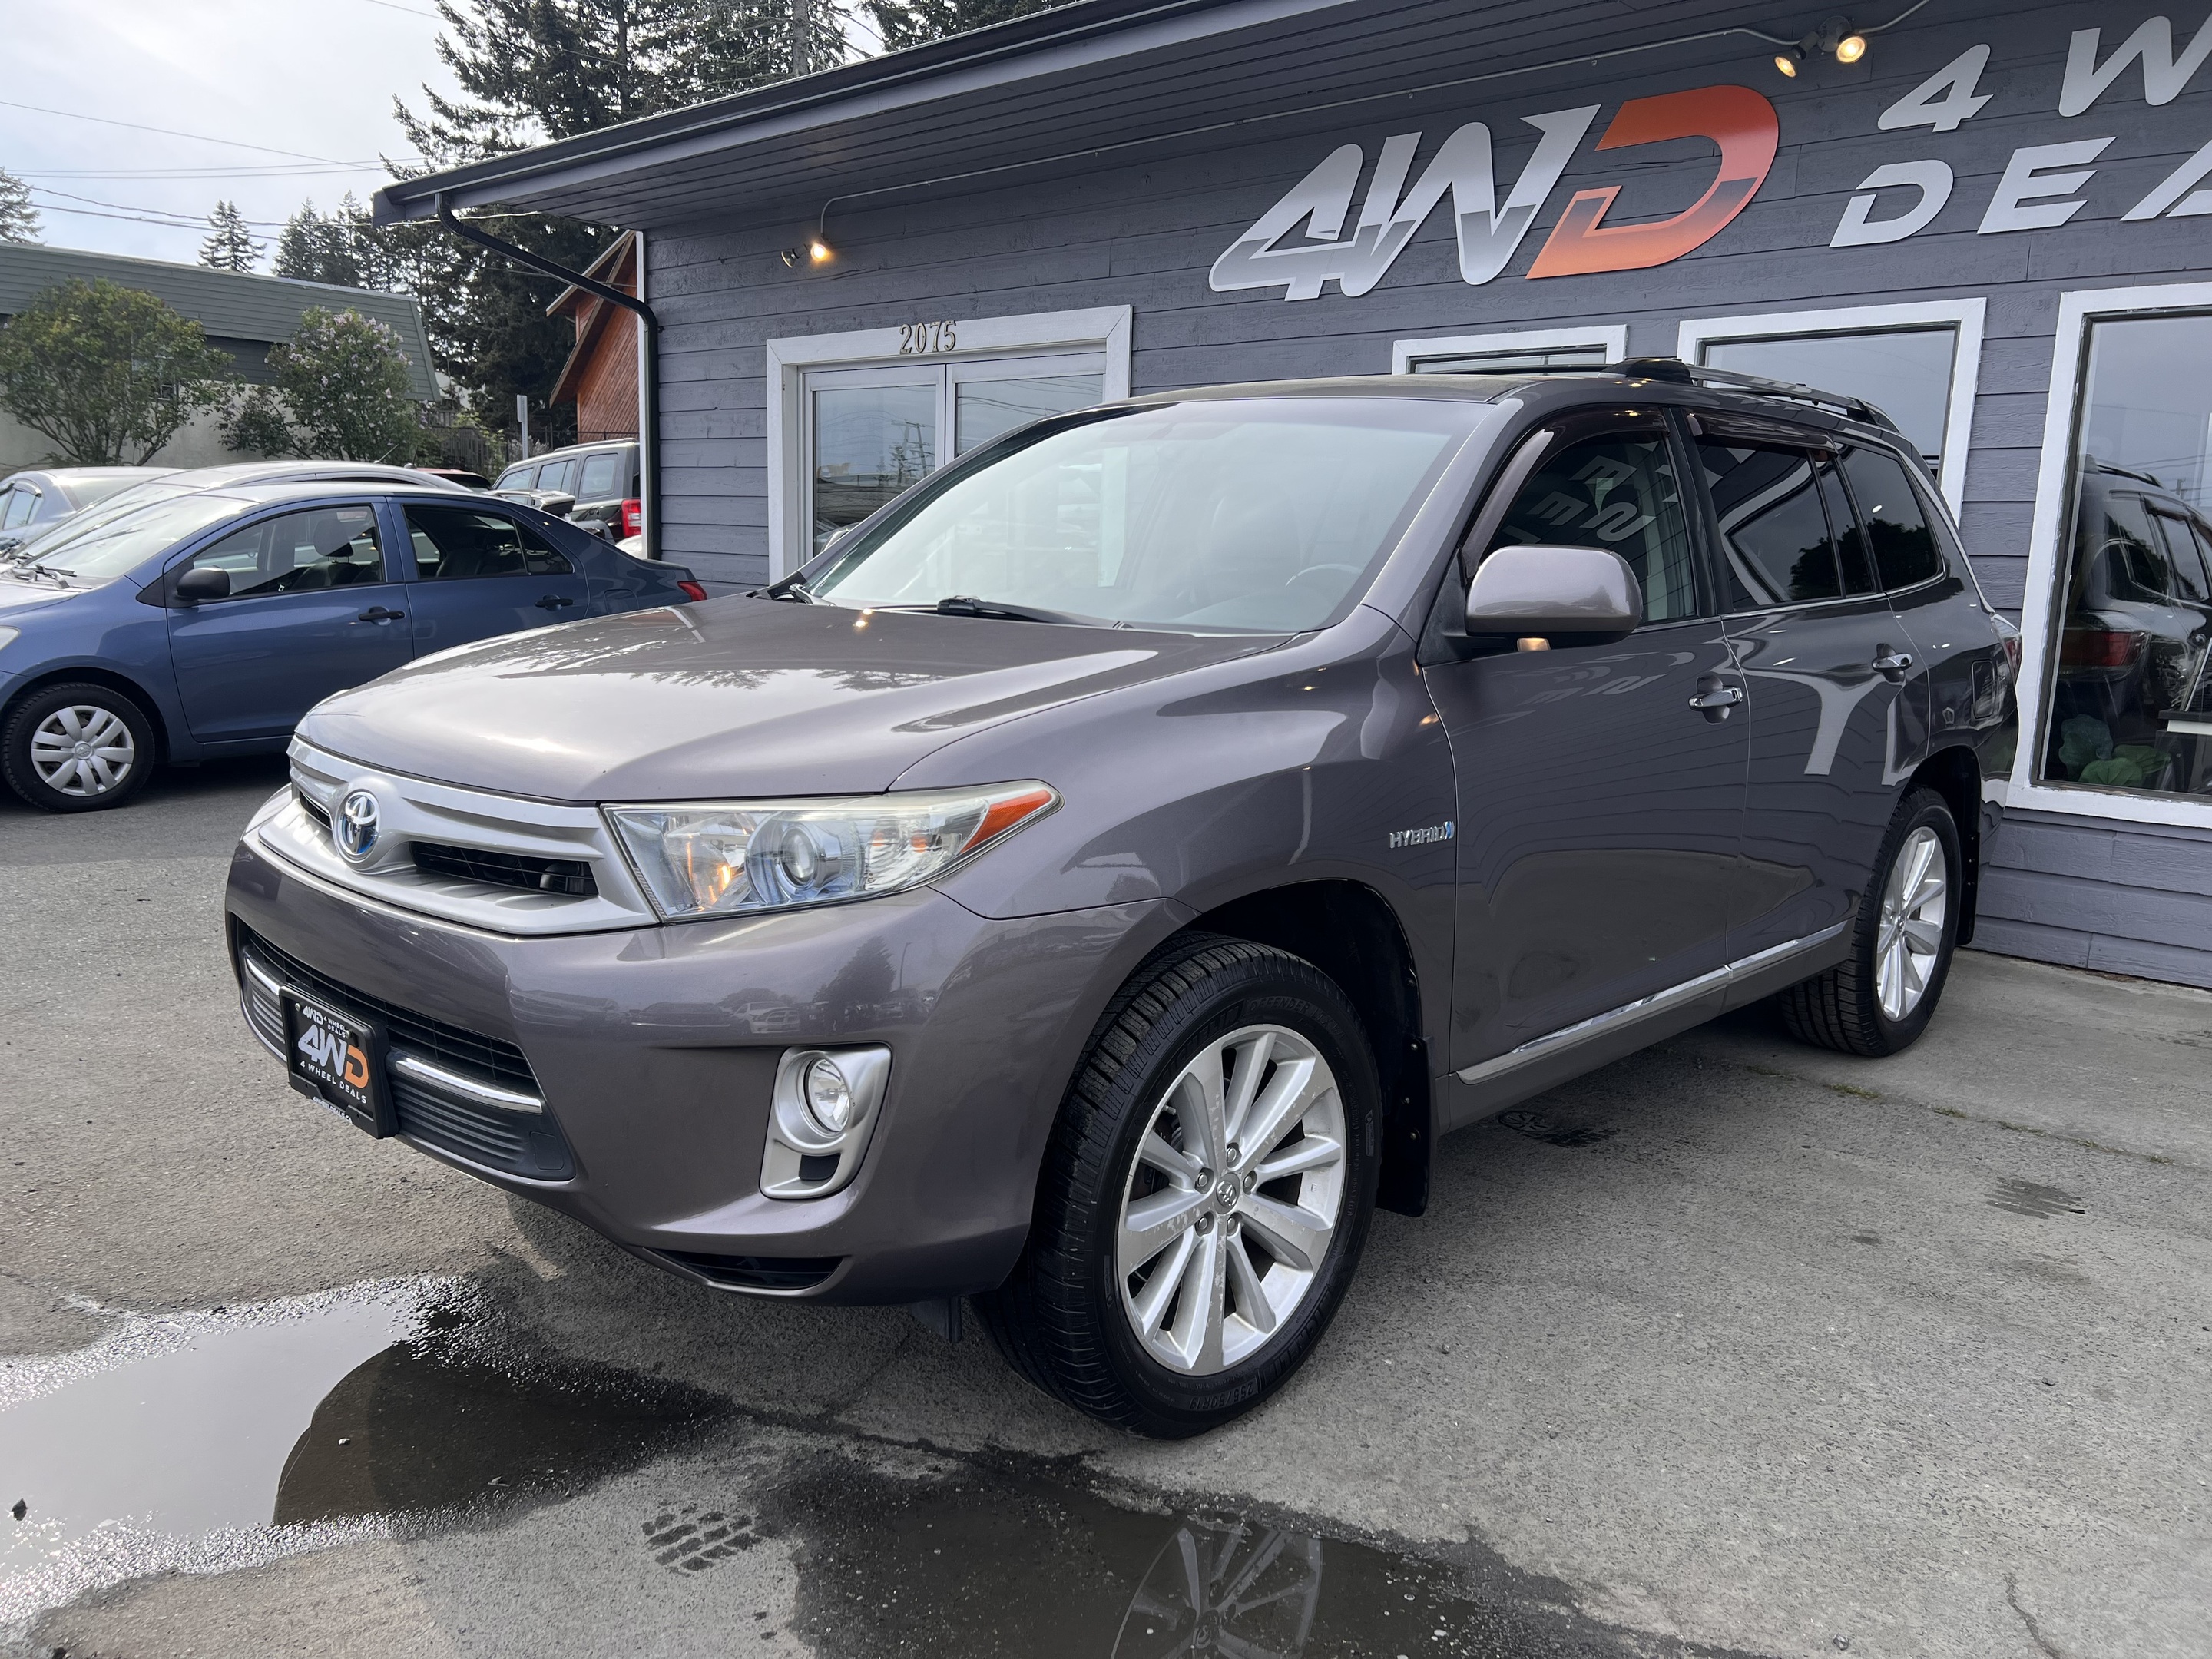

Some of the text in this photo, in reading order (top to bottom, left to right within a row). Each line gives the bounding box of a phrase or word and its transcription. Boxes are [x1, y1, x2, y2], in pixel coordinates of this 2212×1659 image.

[1877, 43, 1994, 132] 4
[1209, 84, 1780, 300] 4WD
[899, 320, 957, 355] 2075
[1389, 826, 1445, 849] HYBRID
[303, 1005, 323, 1025] 4WD
[1250, 997, 1310, 1013] DEFENDER
[328, 1018, 346, 1031] WHEEL
[298, 1024, 369, 1088] 4WD
[300, 1060, 366, 1104] 4 WHEEL DEALS
[1189, 1382, 1253, 1410] 255/50R19
